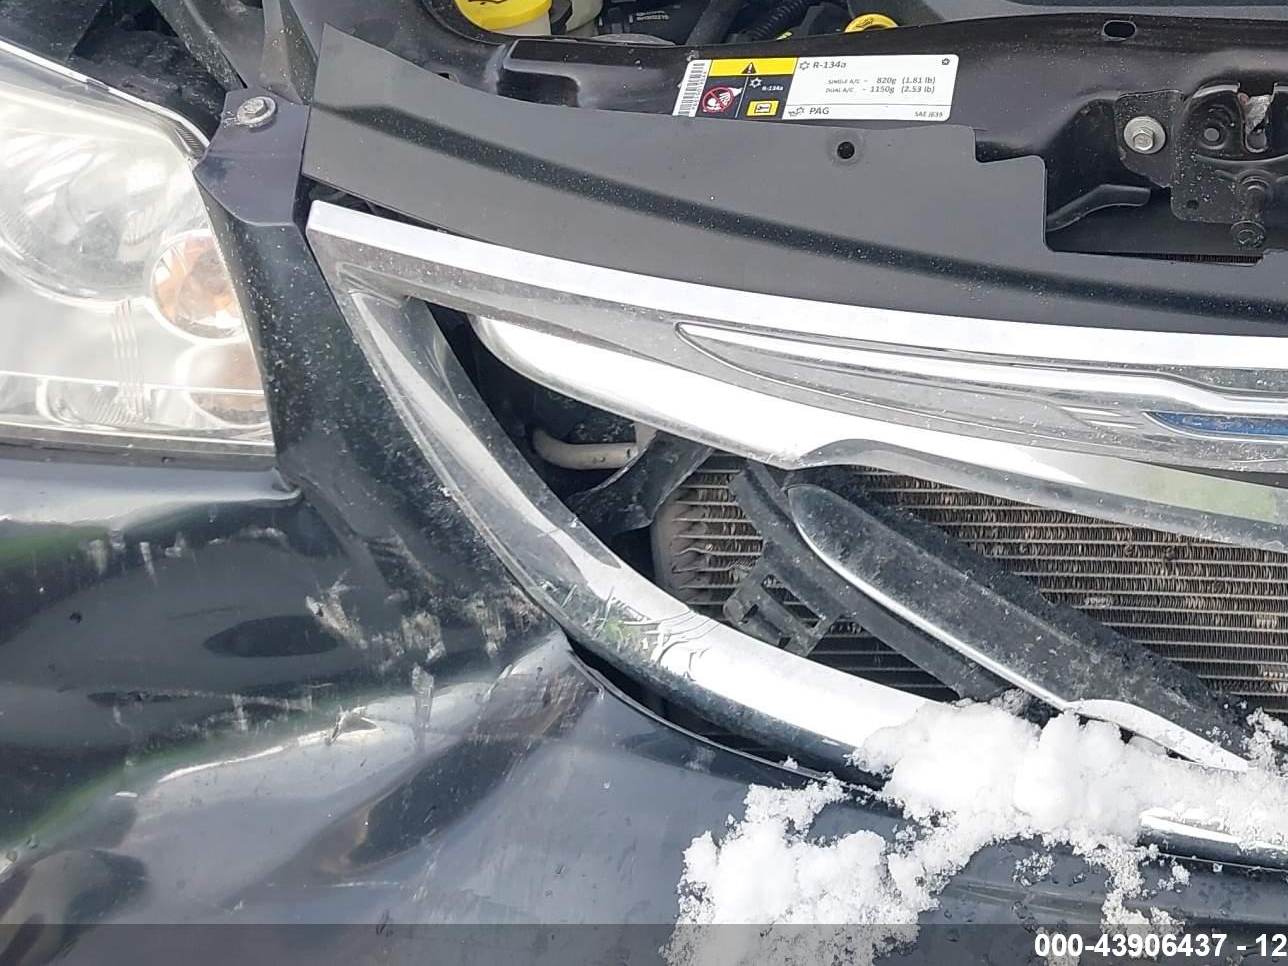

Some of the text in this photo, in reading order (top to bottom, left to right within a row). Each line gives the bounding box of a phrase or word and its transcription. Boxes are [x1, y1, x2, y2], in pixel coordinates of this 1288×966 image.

[812, 60, 846, 68] R-134a
[876, 76, 896, 85] 820g
[902, 76, 922, 84] (1.81
[924, 76, 936, 84] lb)
[901, 86, 922, 94] (2.53
